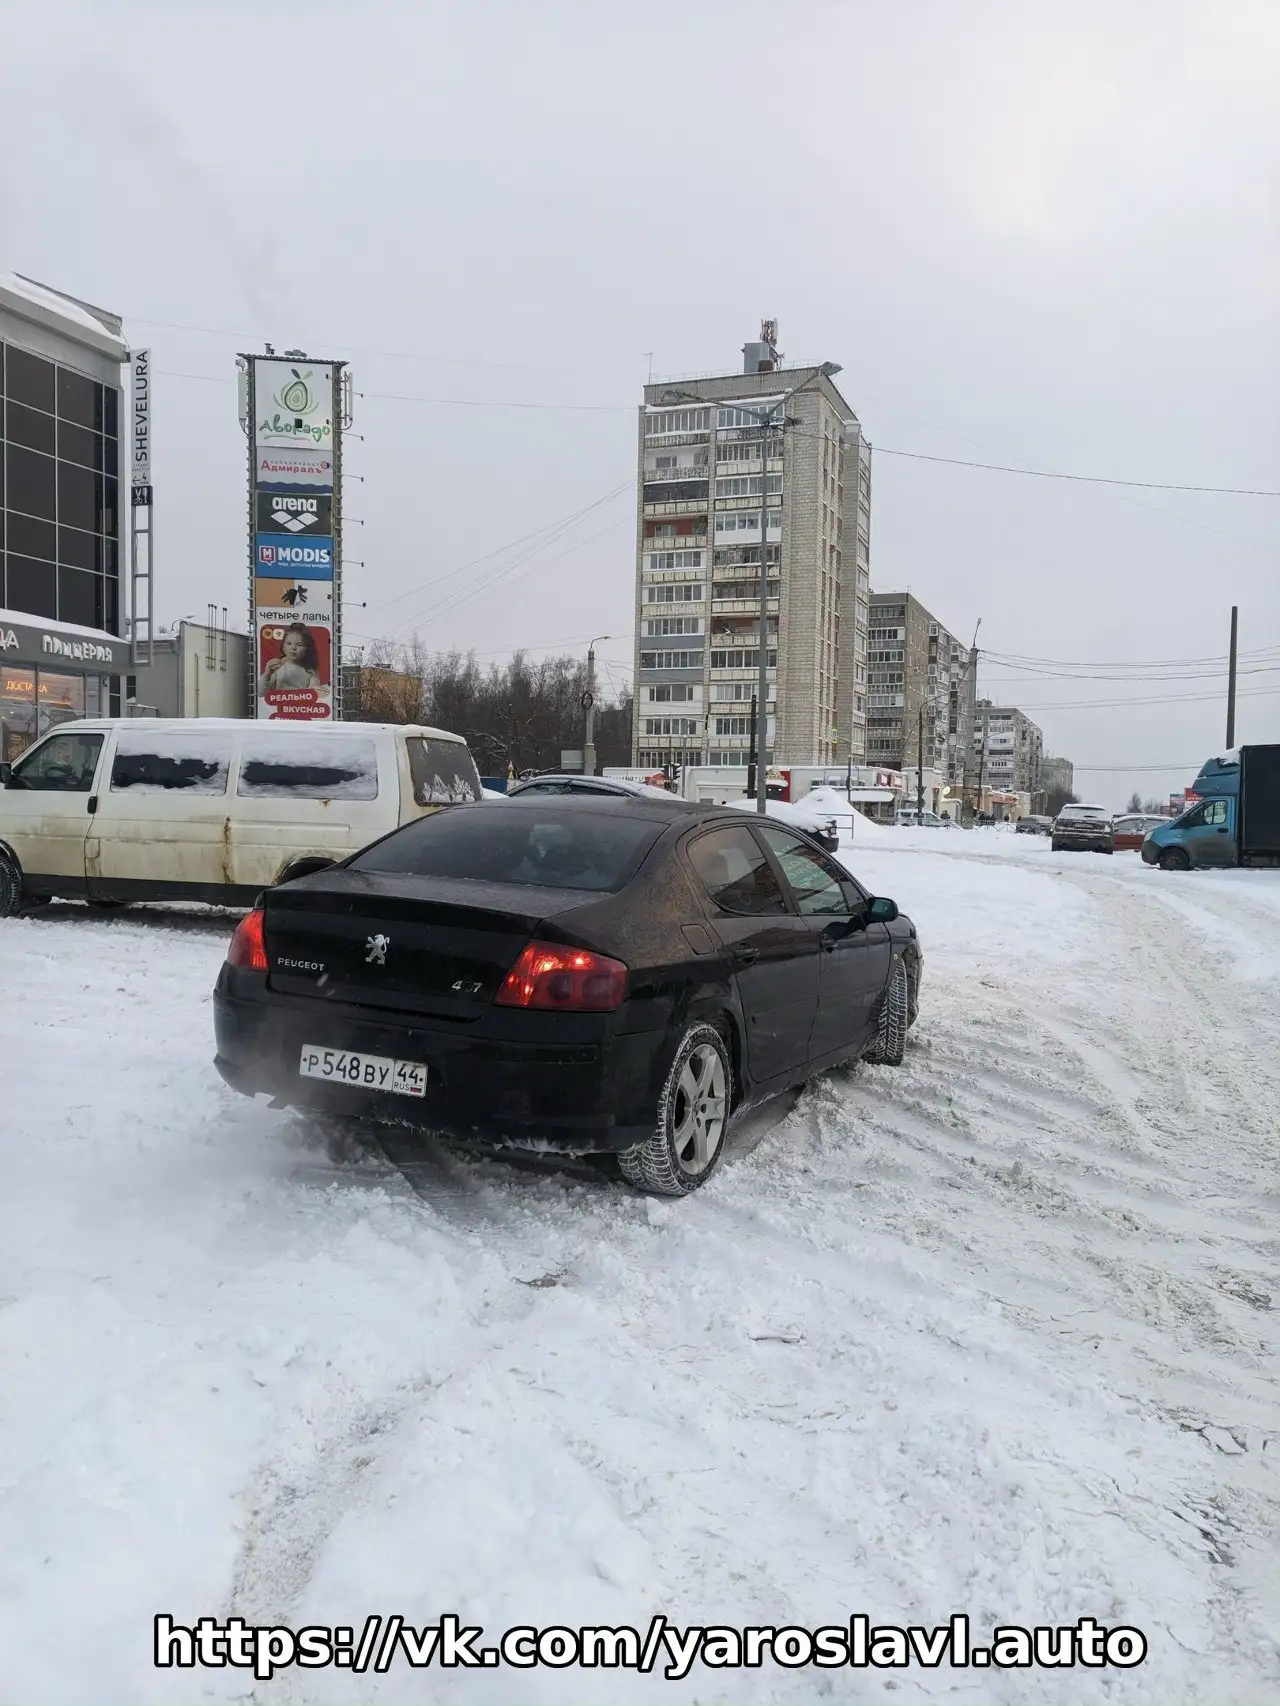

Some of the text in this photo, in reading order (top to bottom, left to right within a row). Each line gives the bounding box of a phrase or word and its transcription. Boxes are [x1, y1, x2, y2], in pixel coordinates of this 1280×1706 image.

[136, 350, 148, 462] SHEVELURA
[271, 496, 317, 512] arena
[277, 547, 330, 563] MODIS
[260, 611, 330, 621] четыре лапы
[42, 634, 113, 662] ПИЦЦЕРИЯ
[5, 680, 48, 694] ДОСТАКА
[270, 693, 313, 702] РЕАЛЬНО
[282, 706, 325, 714] ВКУСНАЯ
[277, 957, 325, 972] PEUGEOT
[308, 1051, 419, 1085] Р548ВУ 44
[393, 1081, 410, 1091] RUS
